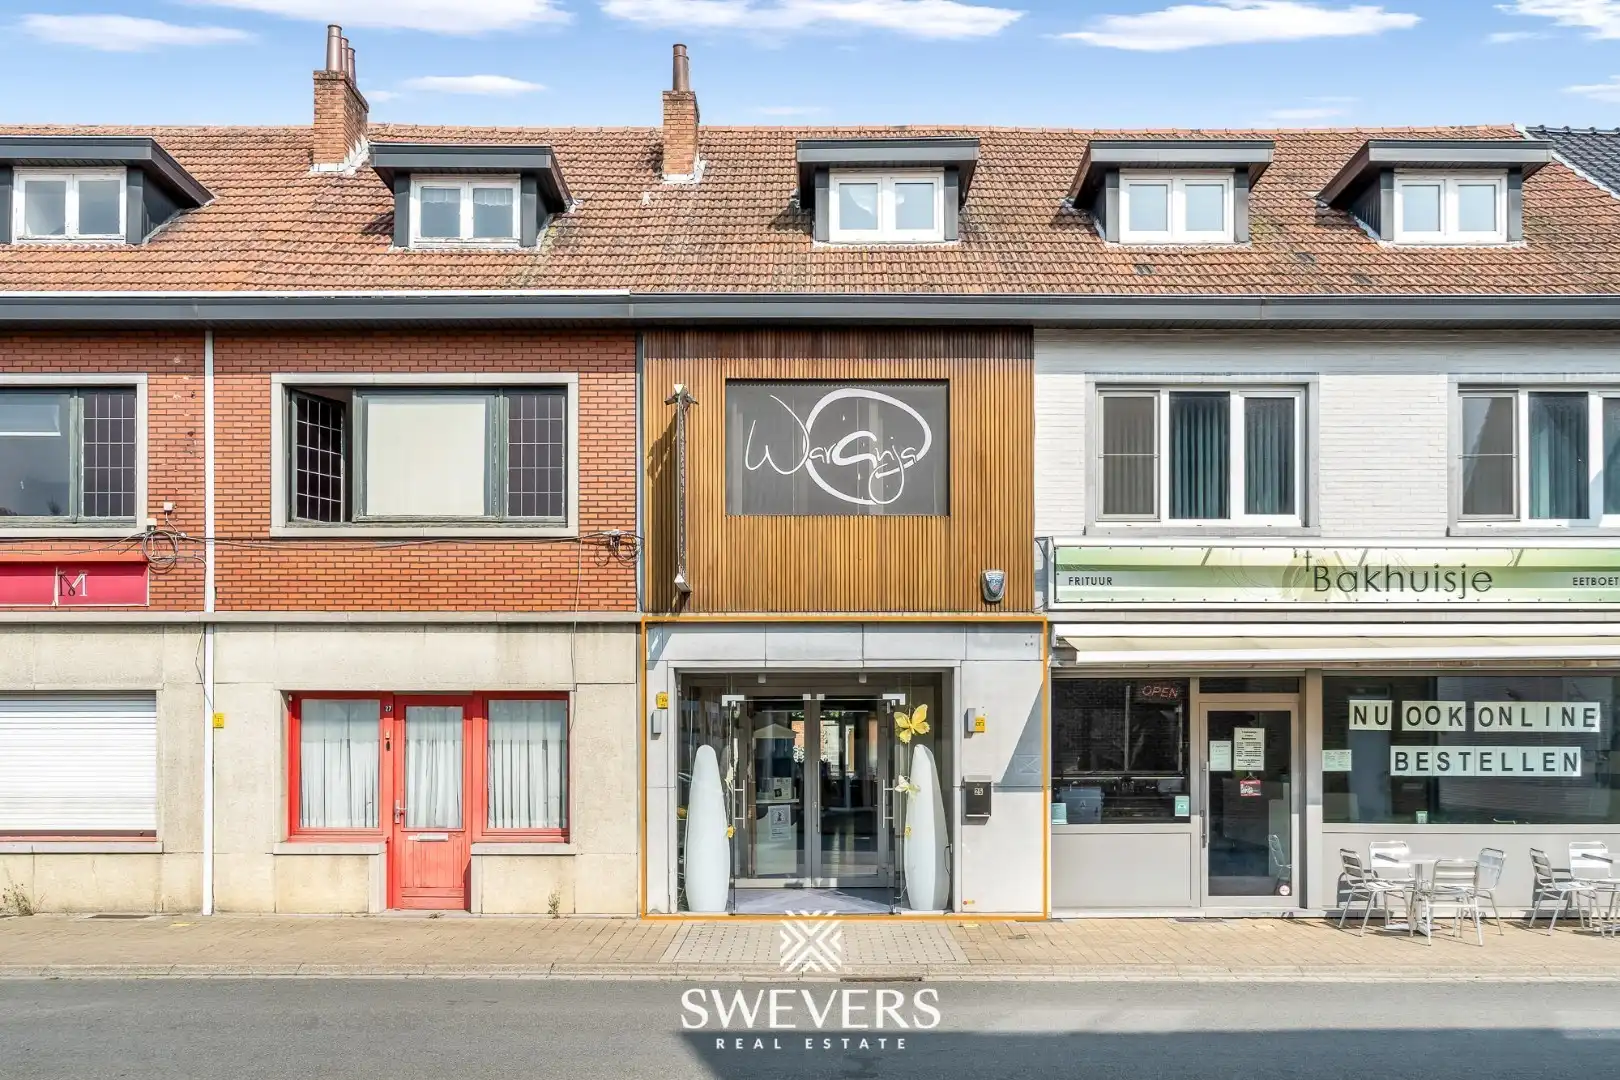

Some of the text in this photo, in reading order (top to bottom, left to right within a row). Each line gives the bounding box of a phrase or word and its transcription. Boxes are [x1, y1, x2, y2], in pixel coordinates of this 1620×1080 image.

[1068, 576, 1113, 586] FRITUUR
[1314, 564, 1493, 599] Bakhuisje
[1142, 685, 1178, 698] OPEN
[1354, 705, 1596, 728] NU OOK ONLINE
[1394, 751, 1578, 773] BESTELLEN
[974, 788, 983, 796] 25
